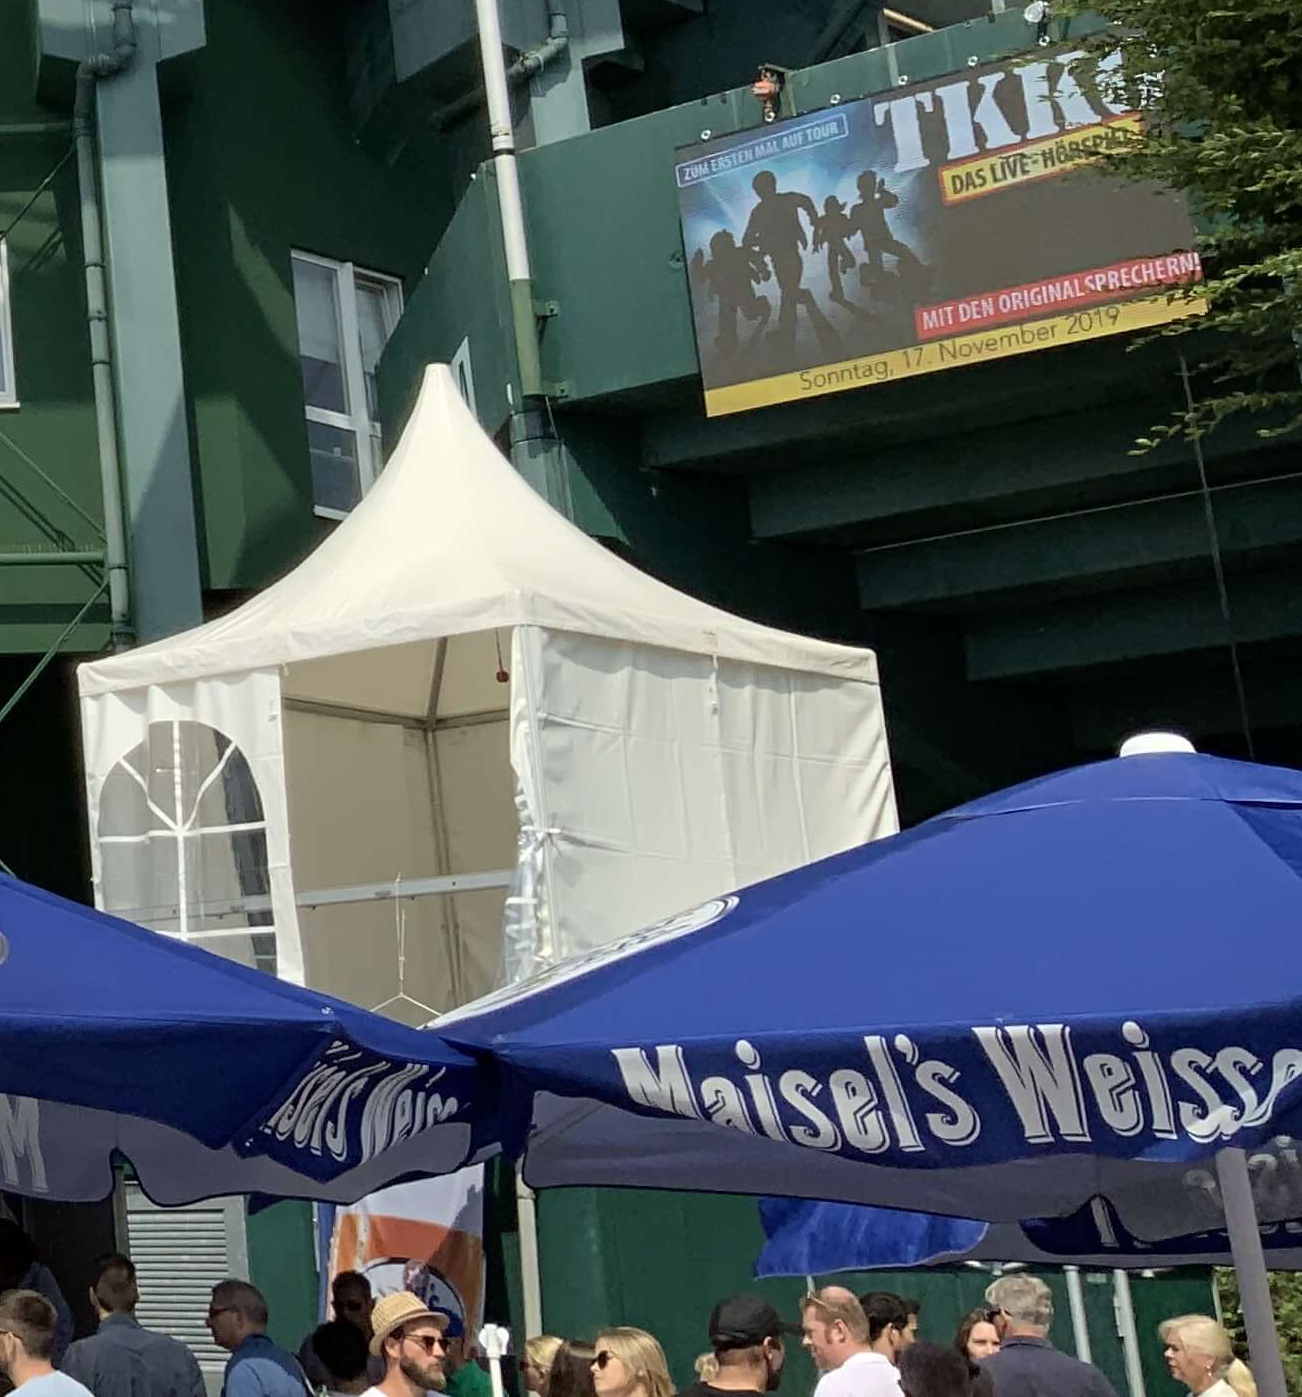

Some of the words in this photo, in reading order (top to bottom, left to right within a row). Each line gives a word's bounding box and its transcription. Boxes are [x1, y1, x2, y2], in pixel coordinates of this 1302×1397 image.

[683, 164, 710, 181] ZUM
[711, 150, 754, 172] ERSTEN
[754, 141, 781, 159] MAL
[781, 133, 805, 150] AUF
[807, 121, 838, 142] TOUR
[951, 168, 987, 195] DAS
[923, 305, 953, 330] MIT
[958, 296, 995, 322] DEN
[799, 354, 893, 391] Sonntag,
[901, 347, 932, 369] 17.
[939, 320, 1058, 364] November
[1064, 305, 1121, 336] 2019
[611, 1038, 982, 1154] Maisel's
